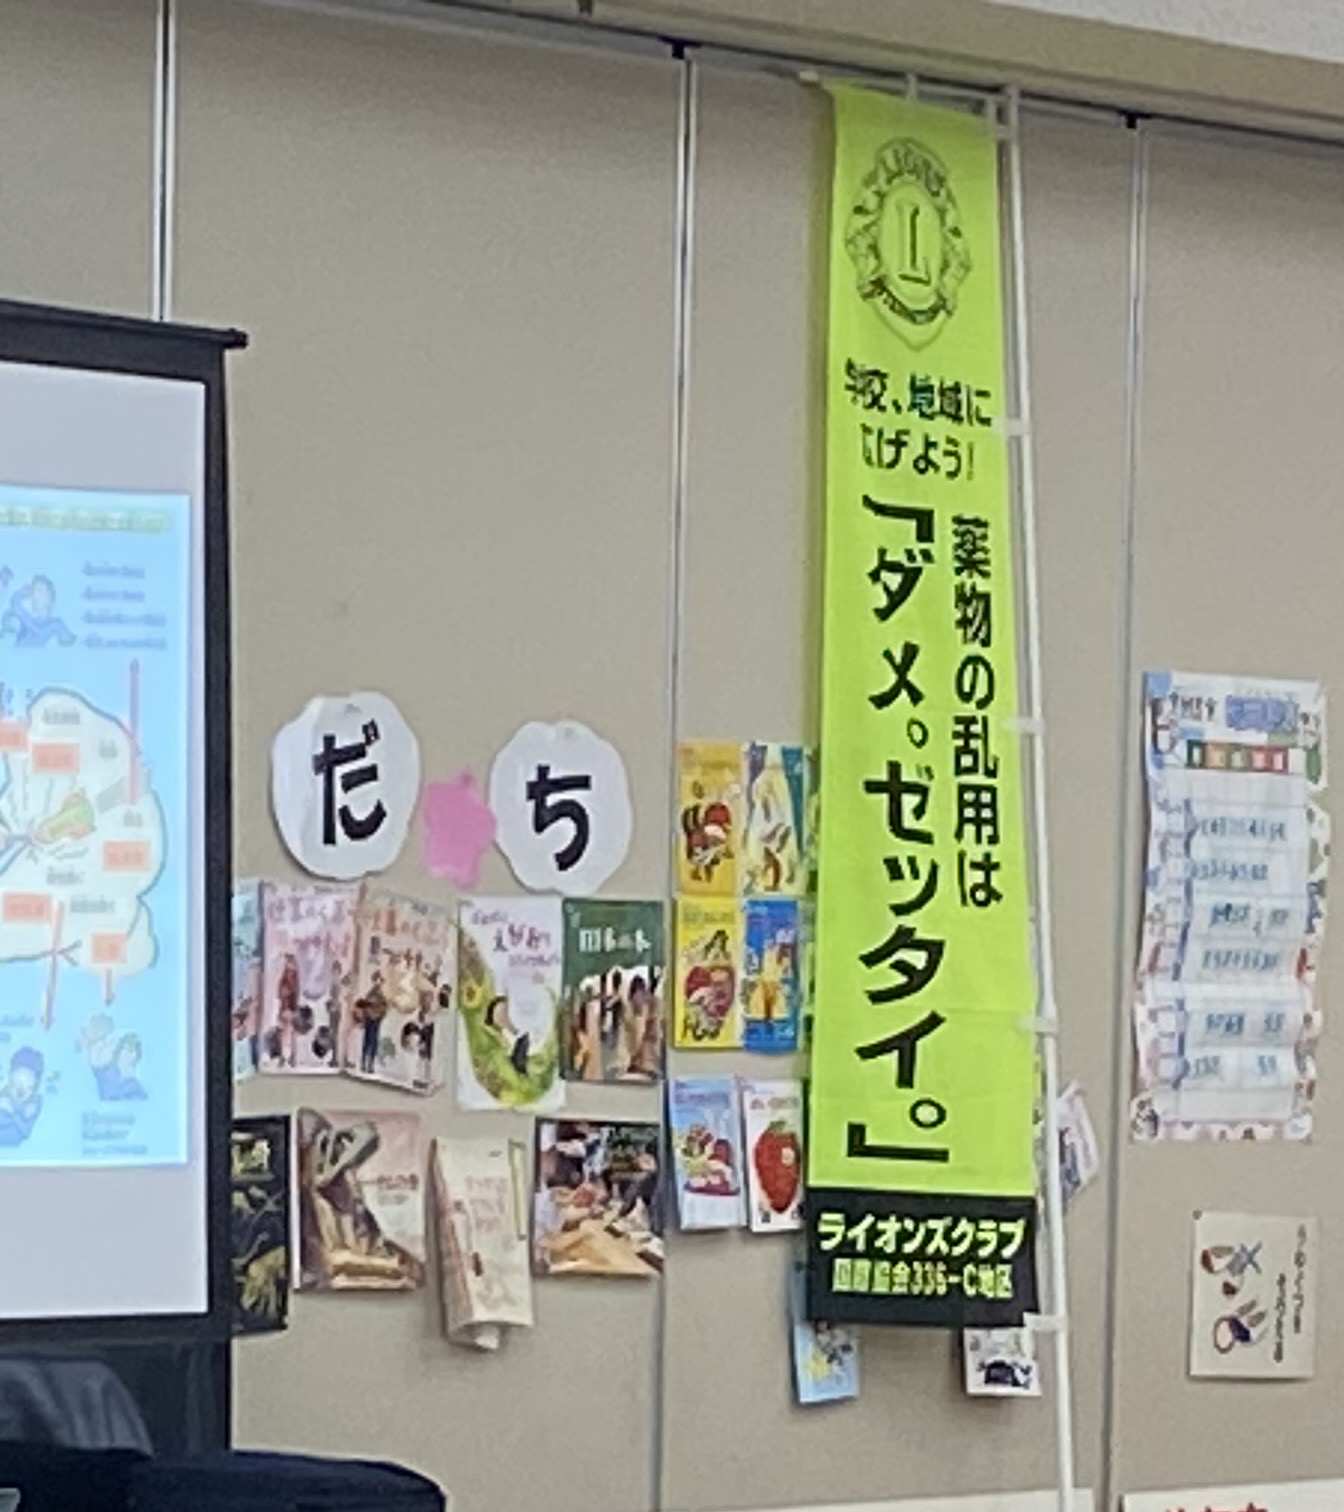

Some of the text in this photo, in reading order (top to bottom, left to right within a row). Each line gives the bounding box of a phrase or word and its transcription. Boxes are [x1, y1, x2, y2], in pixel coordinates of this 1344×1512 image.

[313, 717, 593, 872] だ ち
[846, 494, 950, 1167] 「ダメ。ゼッタイ。」
[951, 513, 1003, 908] 薬物の乱用は
[817, 1211, 1026, 1260] ライオンズクラブ
